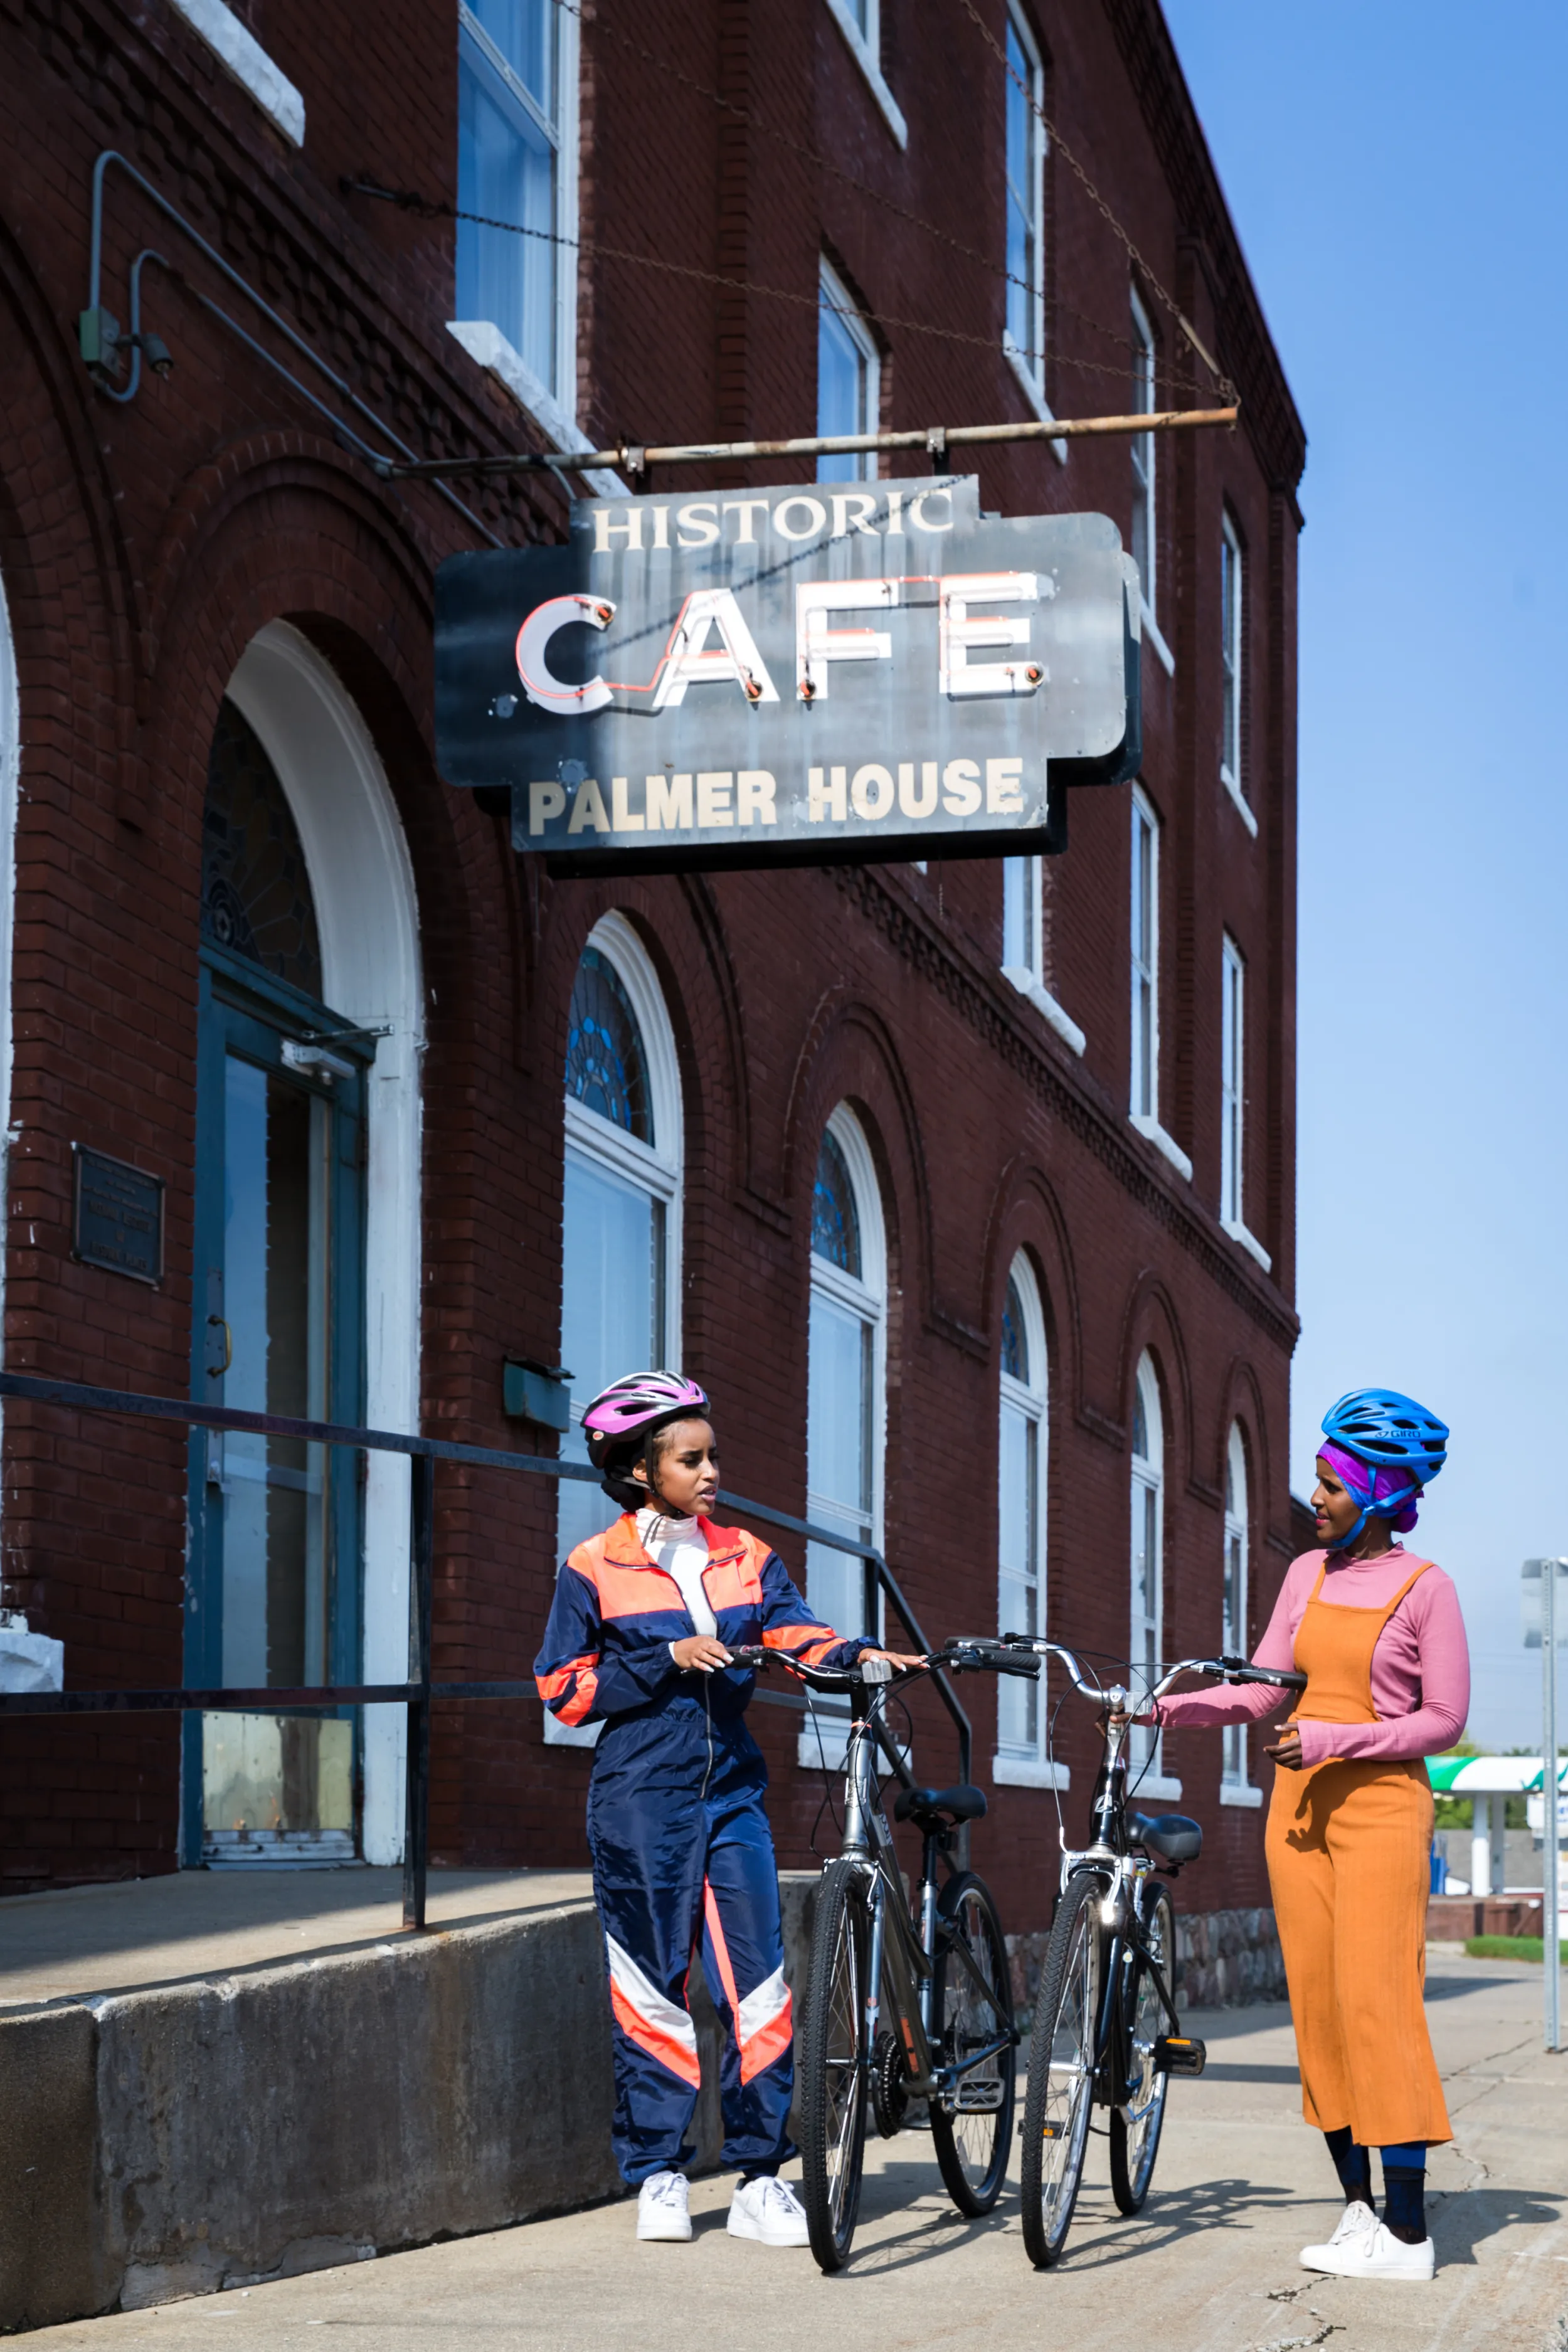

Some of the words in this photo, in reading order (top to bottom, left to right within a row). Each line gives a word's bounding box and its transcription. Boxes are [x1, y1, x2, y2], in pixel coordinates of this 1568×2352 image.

[592, 489, 955, 553] HISTORIC
[516, 571, 1038, 715] CAFE
[529, 770, 777, 836] PALMER
[808, 758, 1024, 822] HOUSE
[1391, 1430, 1421, 1438] GIRO
